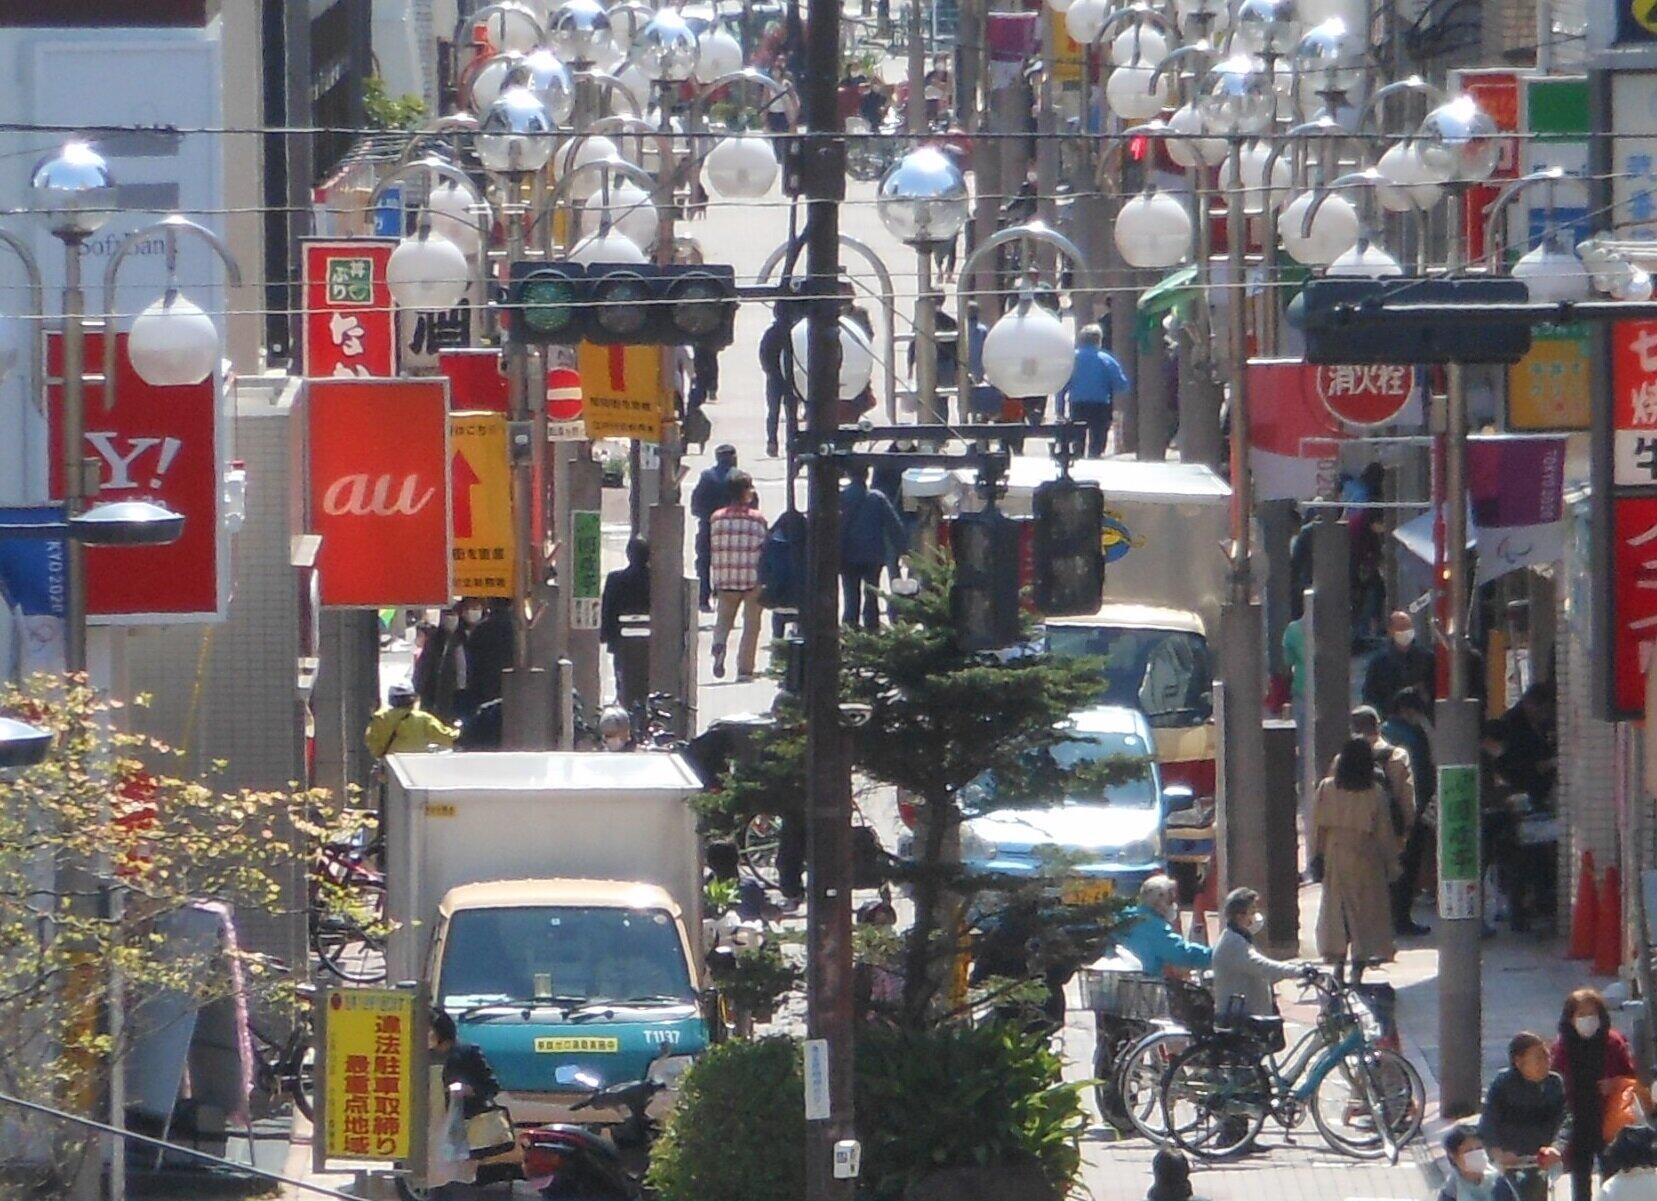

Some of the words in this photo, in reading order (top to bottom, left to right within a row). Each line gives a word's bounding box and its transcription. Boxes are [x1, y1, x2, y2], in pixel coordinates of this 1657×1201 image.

[78, 233, 177, 255] Sofan
[1328, 365, 1405, 396] 消火栓
[84, 432, 182, 489] Y!
[323, 473, 436, 516] au
[46, 541, 64, 573] KYO
[344, 1055, 371, 1155] 最重点地域
[374, 1015, 401, 1156] 違法駐車取締り
